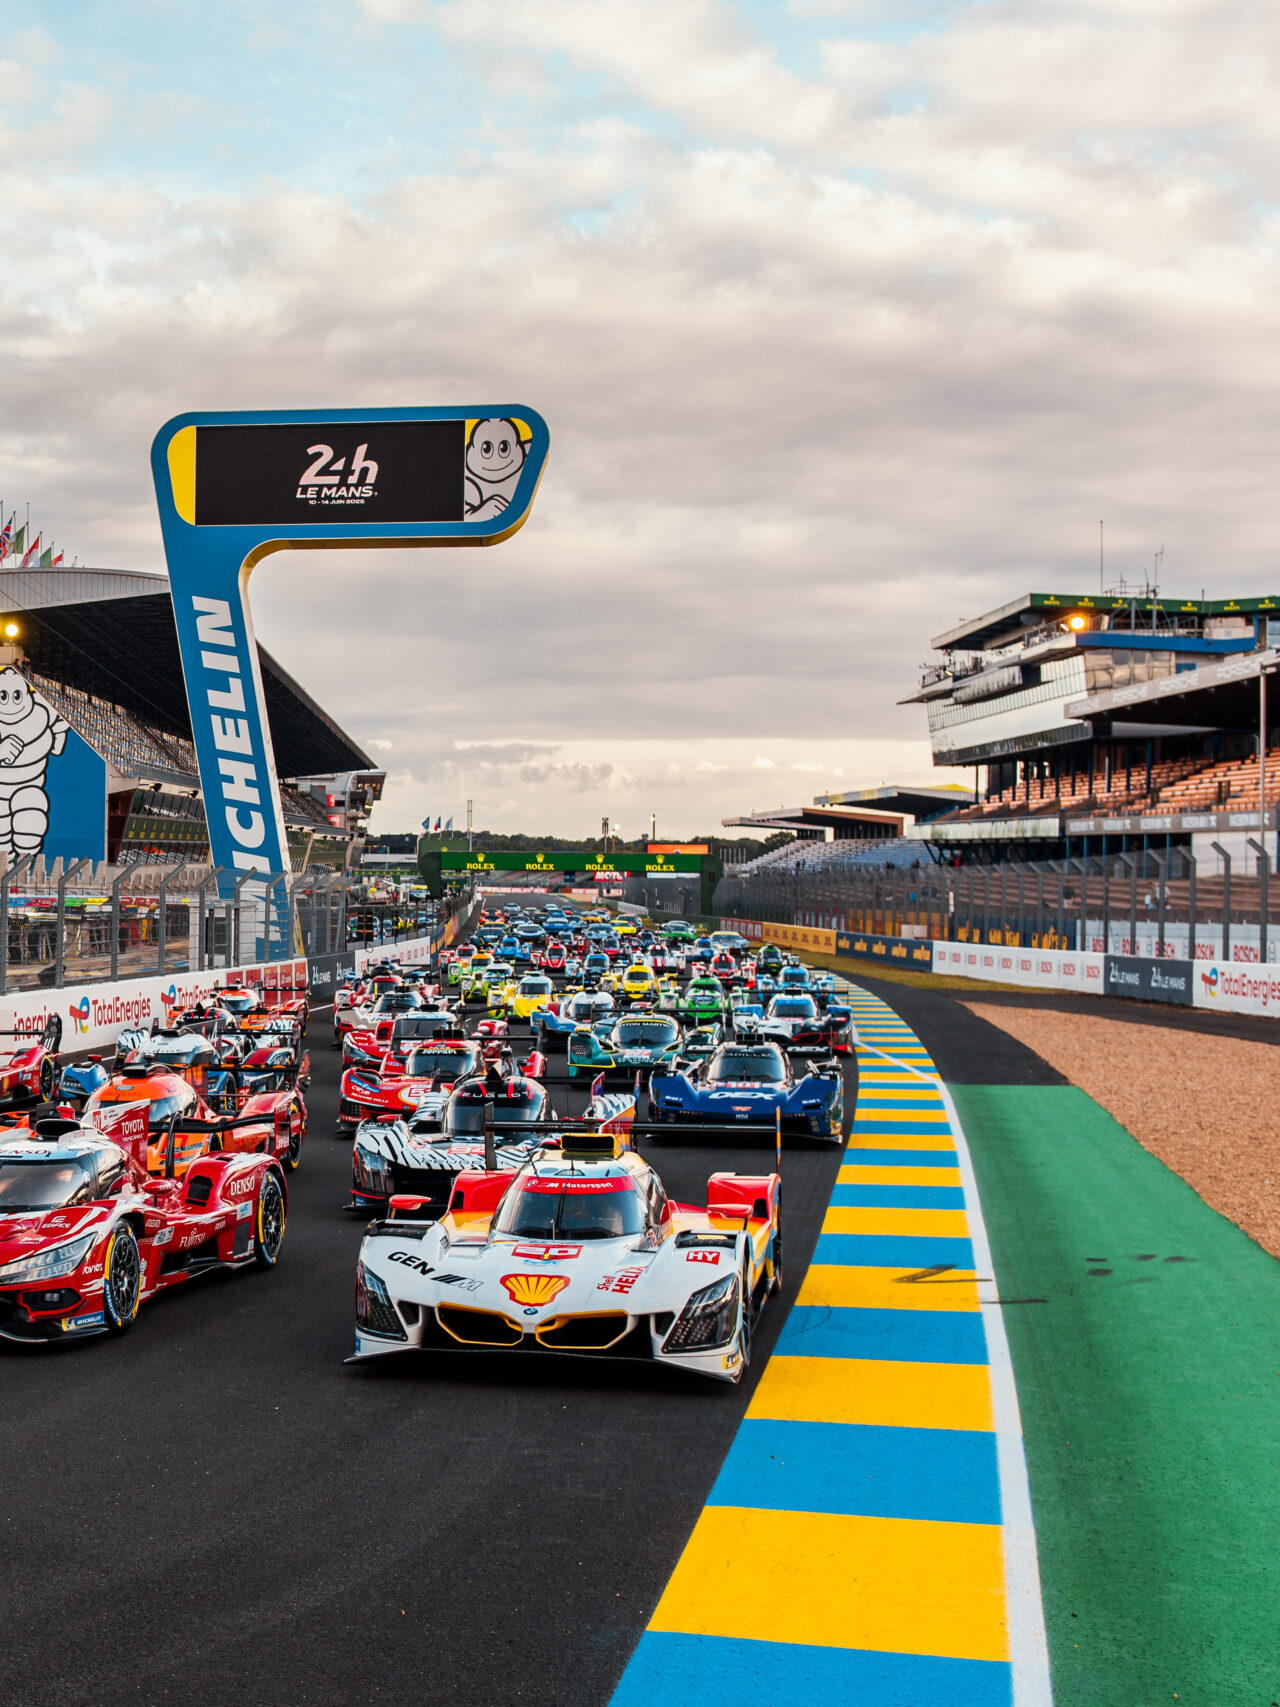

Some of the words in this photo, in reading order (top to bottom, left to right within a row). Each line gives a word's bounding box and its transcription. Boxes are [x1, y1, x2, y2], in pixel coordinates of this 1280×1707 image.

[299, 443, 379, 485] 24h
[296, 487, 319, 498] LE
[321, 486, 373, 498] MANS
[645, 864, 675, 872] ROLEX
[1155, 941, 1175, 958] BSCH
[1195, 943, 1214, 960] OSCH
[1233, 944, 1260, 963] BOSCH
[1086, 965, 1100, 978] BOSCH
[1170, 976, 1185, 990] MANS
[92, 992, 151, 1027] TotalEnergies
[121, 1118, 144, 1134] TOYOTA
[122, 1134, 144, 1142] RACING
[230, 1176, 255, 1196] DENSO
[563, 1181, 614, 1190] Motorsport
[180, 1232, 206, 1248] FUJITSU
[387, 1251, 435, 1276] GEN
[688, 1251, 719, 1263] HY
[597, 1275, 616, 1291] Shell
[612, 1266, 648, 1295] HELIX
[76, 1316, 102, 1325] MICHELIN
